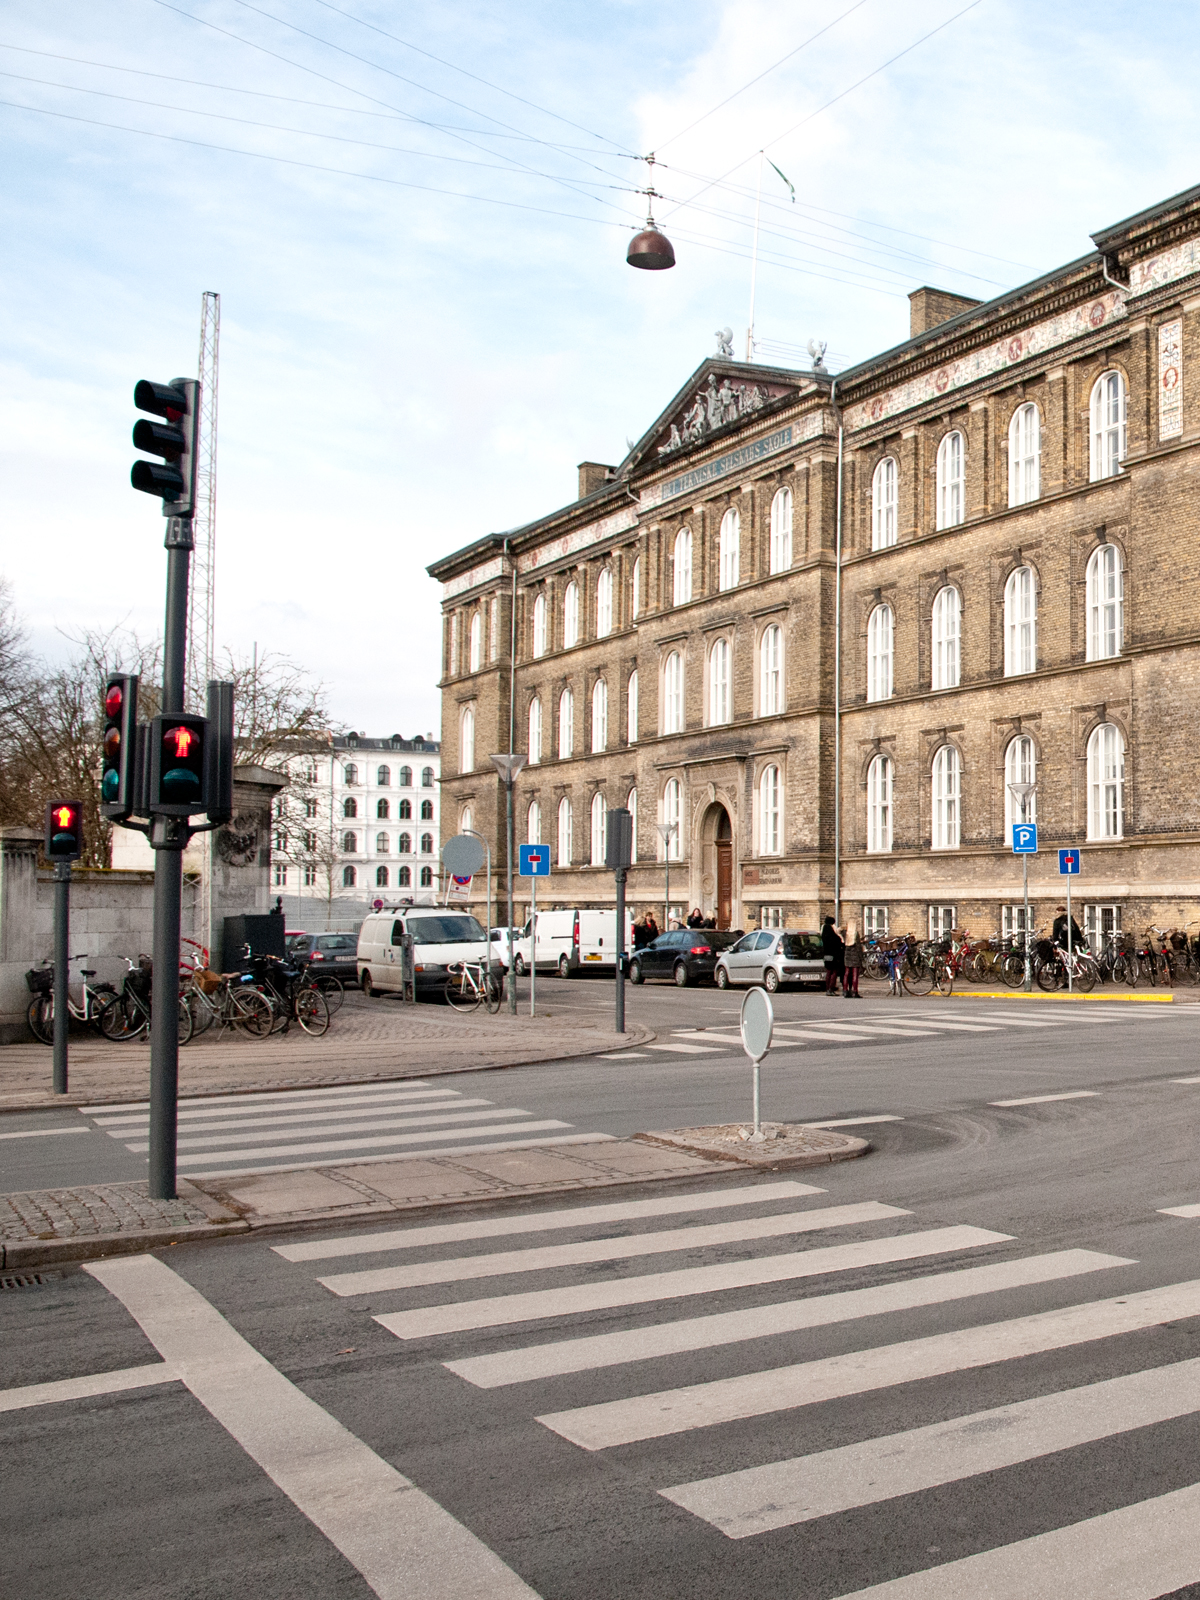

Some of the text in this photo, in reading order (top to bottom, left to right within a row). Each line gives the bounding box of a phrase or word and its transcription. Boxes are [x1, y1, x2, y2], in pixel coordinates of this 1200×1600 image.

[663, 429, 790, 499] DET TEKNISKE SELSKABS SKOLE
[1020, 832, 1030, 845] P
